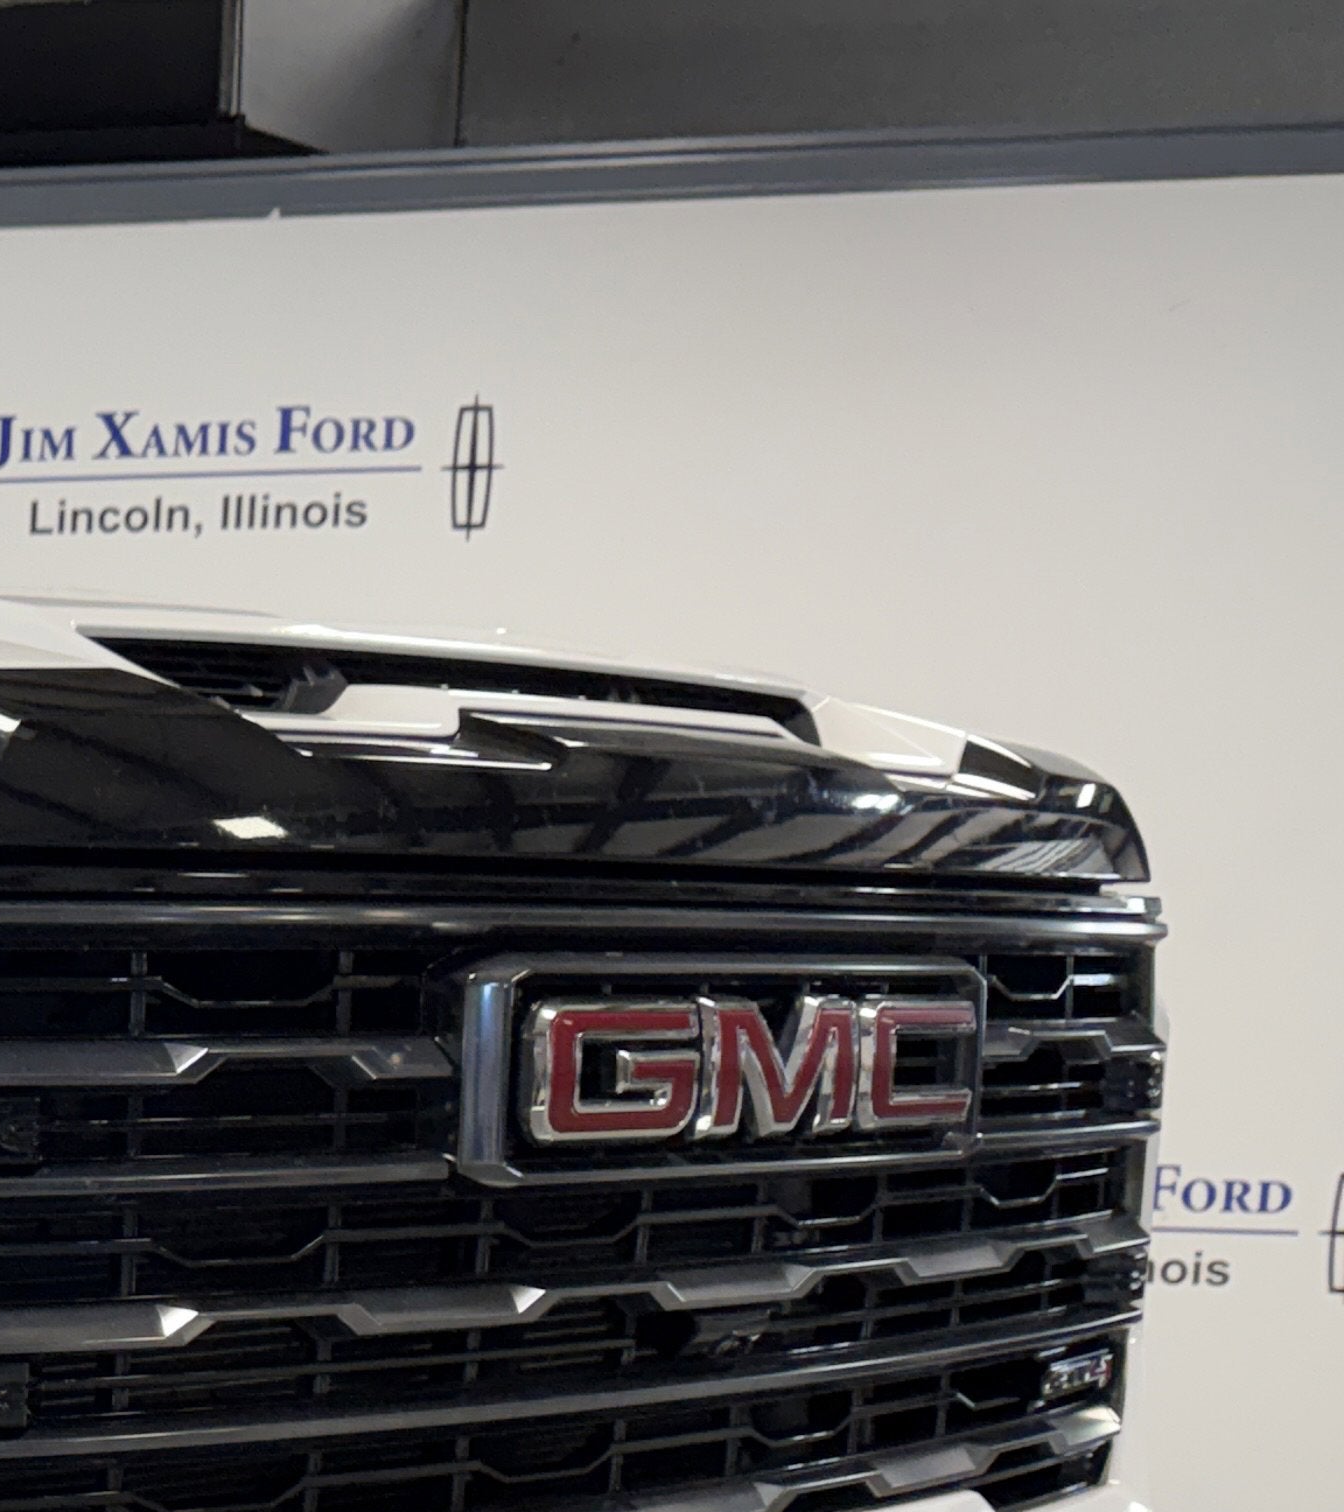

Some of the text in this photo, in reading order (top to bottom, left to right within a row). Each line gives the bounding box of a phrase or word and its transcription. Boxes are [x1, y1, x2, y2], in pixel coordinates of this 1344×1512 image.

[30, 491, 368, 538] Lincoln, Illinois
[520, 994, 977, 1142] GMC
